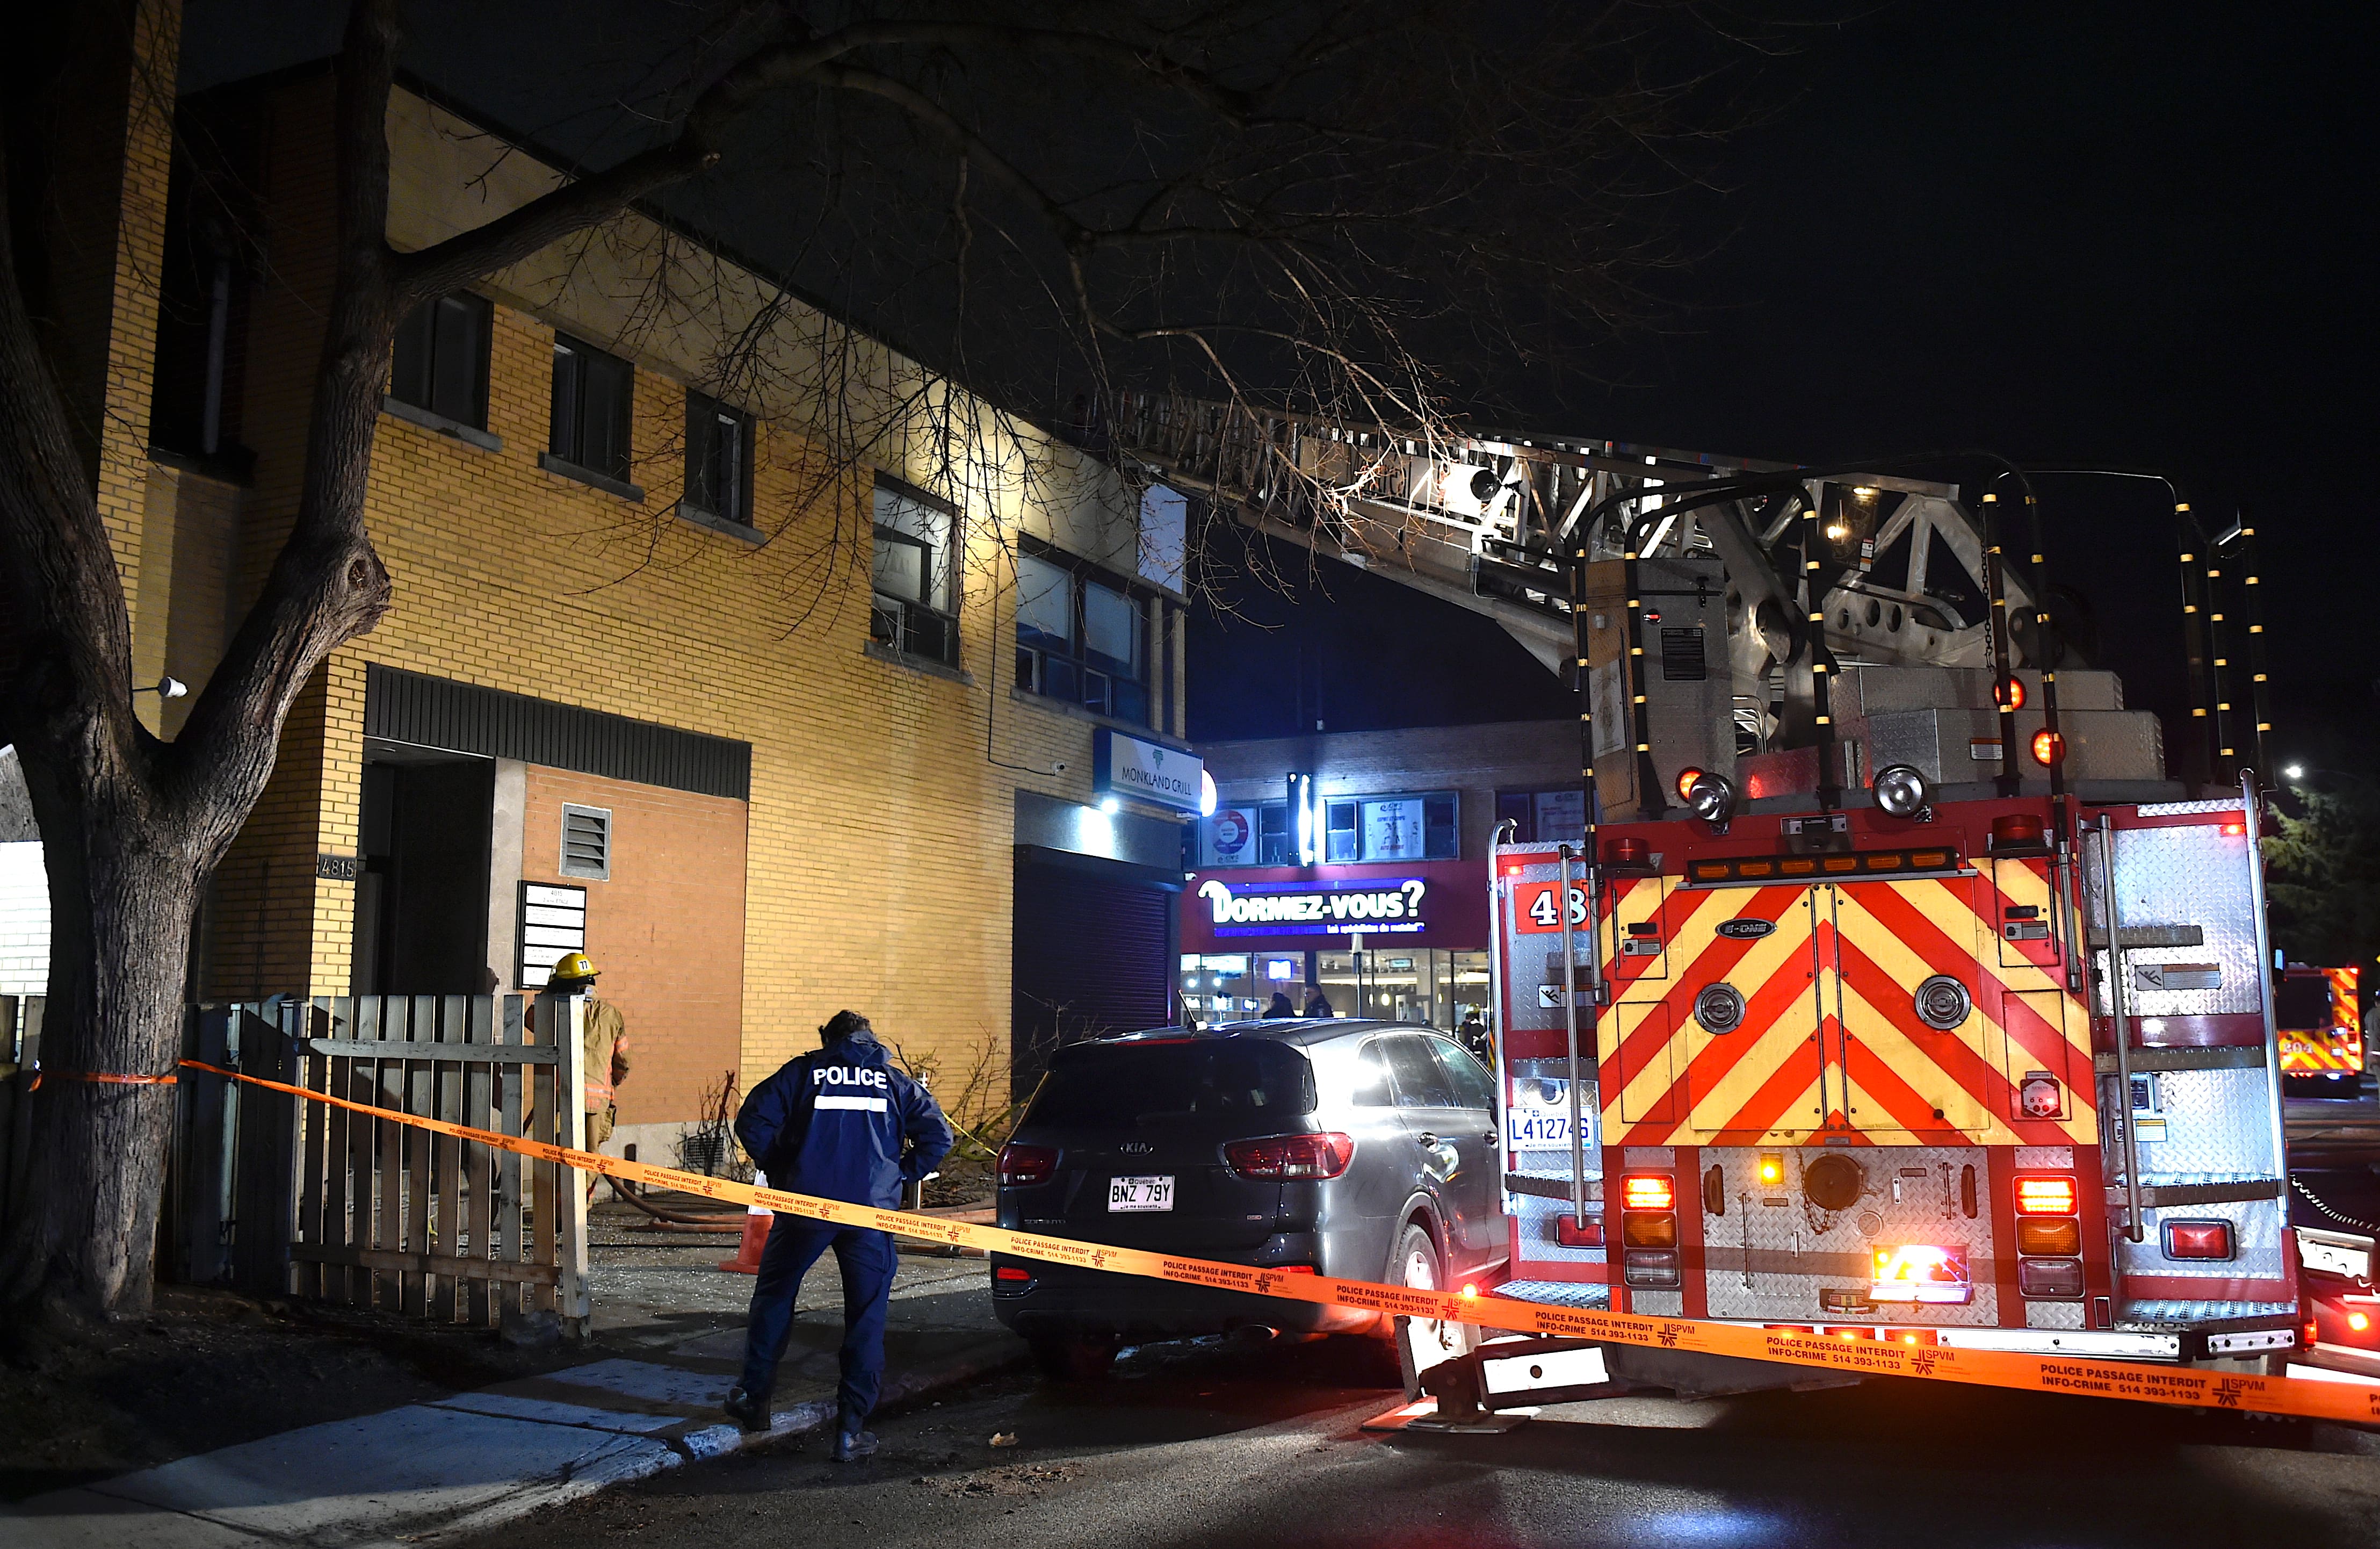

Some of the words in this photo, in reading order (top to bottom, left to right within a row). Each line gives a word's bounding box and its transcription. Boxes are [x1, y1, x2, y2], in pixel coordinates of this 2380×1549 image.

[1122, 766, 1170, 790] MONKLAND
[1173, 780, 1191, 795] GRILL
[322, 858, 355, 877] 4815
[1198, 880, 1426, 923] DORMEZ-VOUS?
[1529, 888, 1588, 926] 48
[1725, 924, 1767, 933] E-ONE
[813, 1066, 887, 1090] POLICE
[1126, 1143, 1147, 1152] KIA
[645, 1169, 659, 1178] POLICE
[660, 1172, 680, 1181] PASSAGE
[681, 1177, 702, 1186] INTERDIT
[754, 1191, 771, 1200] POLICE
[772, 1195, 793, 1204] PASSAGE
[795, 1199, 818, 1209] INTERDIT
[1112, 1185, 1137, 1202] BNZ
[1146, 1184, 1170, 1201] 79Y
[876, 1214, 894, 1222] POLICE
[896, 1217, 919, 1227] PASSAGE
[921, 1222, 946, 1231] INTERDIT
[876, 1222, 906, 1232] INFO-CRIME
[956, 1225, 971, 1234] SPVM
[1011, 1237, 1032, 1246] POLICE
[1033, 1241, 1060, 1251] PASSAGE
[1061, 1245, 1090, 1256] INTERDIT
[1011, 1245, 1044, 1256] INFO-CRIME
[1060, 1253, 1086, 1263] 393-1133
[1101, 1249, 1117, 1258] SPVM
[1163, 1261, 1187, 1271] POLICE
[1189, 1265, 1219, 1275] PASSAGE
[1220, 1270, 1253, 1280] INTERDIT
[1163, 1270, 1202, 1281] INFO-CRIME
[1218, 1278, 1249, 1288] 393-1133
[1265, 1273, 1284, 1283] SPVM
[1336, 1285, 1363, 1295] POLICE
[1365, 1289, 1400, 1300] PASSAGE
[1402, 1294, 1439, 1306] INTERDIT
[1337, 1295, 1381, 1307] INFO-CRIME
[1384, 1302, 1398, 1310] 514
[1400, 1304, 1435, 1314] 393-1133
[1453, 1298, 1475, 1308] SPVM
[1536, 1312, 1566, 1322] POLICE
[1568, 1315, 1609, 1327] PASSAGE
[1611, 1321, 1653, 1332] INTERDIT
[1671, 1324, 1695, 1335] SPVM
[1537, 1321, 1586, 1334] INFO-CRIME
[1591, 1328, 1606, 1337] 514
[1608, 1331, 1649, 1342] 393-1133
[1767, 1337, 1803, 1348] POLICE
[1805, 1341, 1853, 1353] PASSAGE
[1856, 1346, 1905, 1359] INTERDIT
[1925, 1350, 1955, 1361] SPVM
[1768, 1347, 1827, 1361] INFO-CRIME
[1833, 1354, 1851, 1364] 514
[1854, 1357, 1901, 1370] 393-1133
[2041, 1364, 2084, 1377] POLICE
[2087, 1369, 2143, 1384] PASSAGE
[2147, 1374, 2206, 1388] INTERDIT
[2231, 1378, 2265, 1392] SPVM
[2042, 1375, 2112, 1392] INFO-CRIME
[2118, 1384, 2140, 1395] 514
[2144, 1386, 2200, 1401] 393-1133
